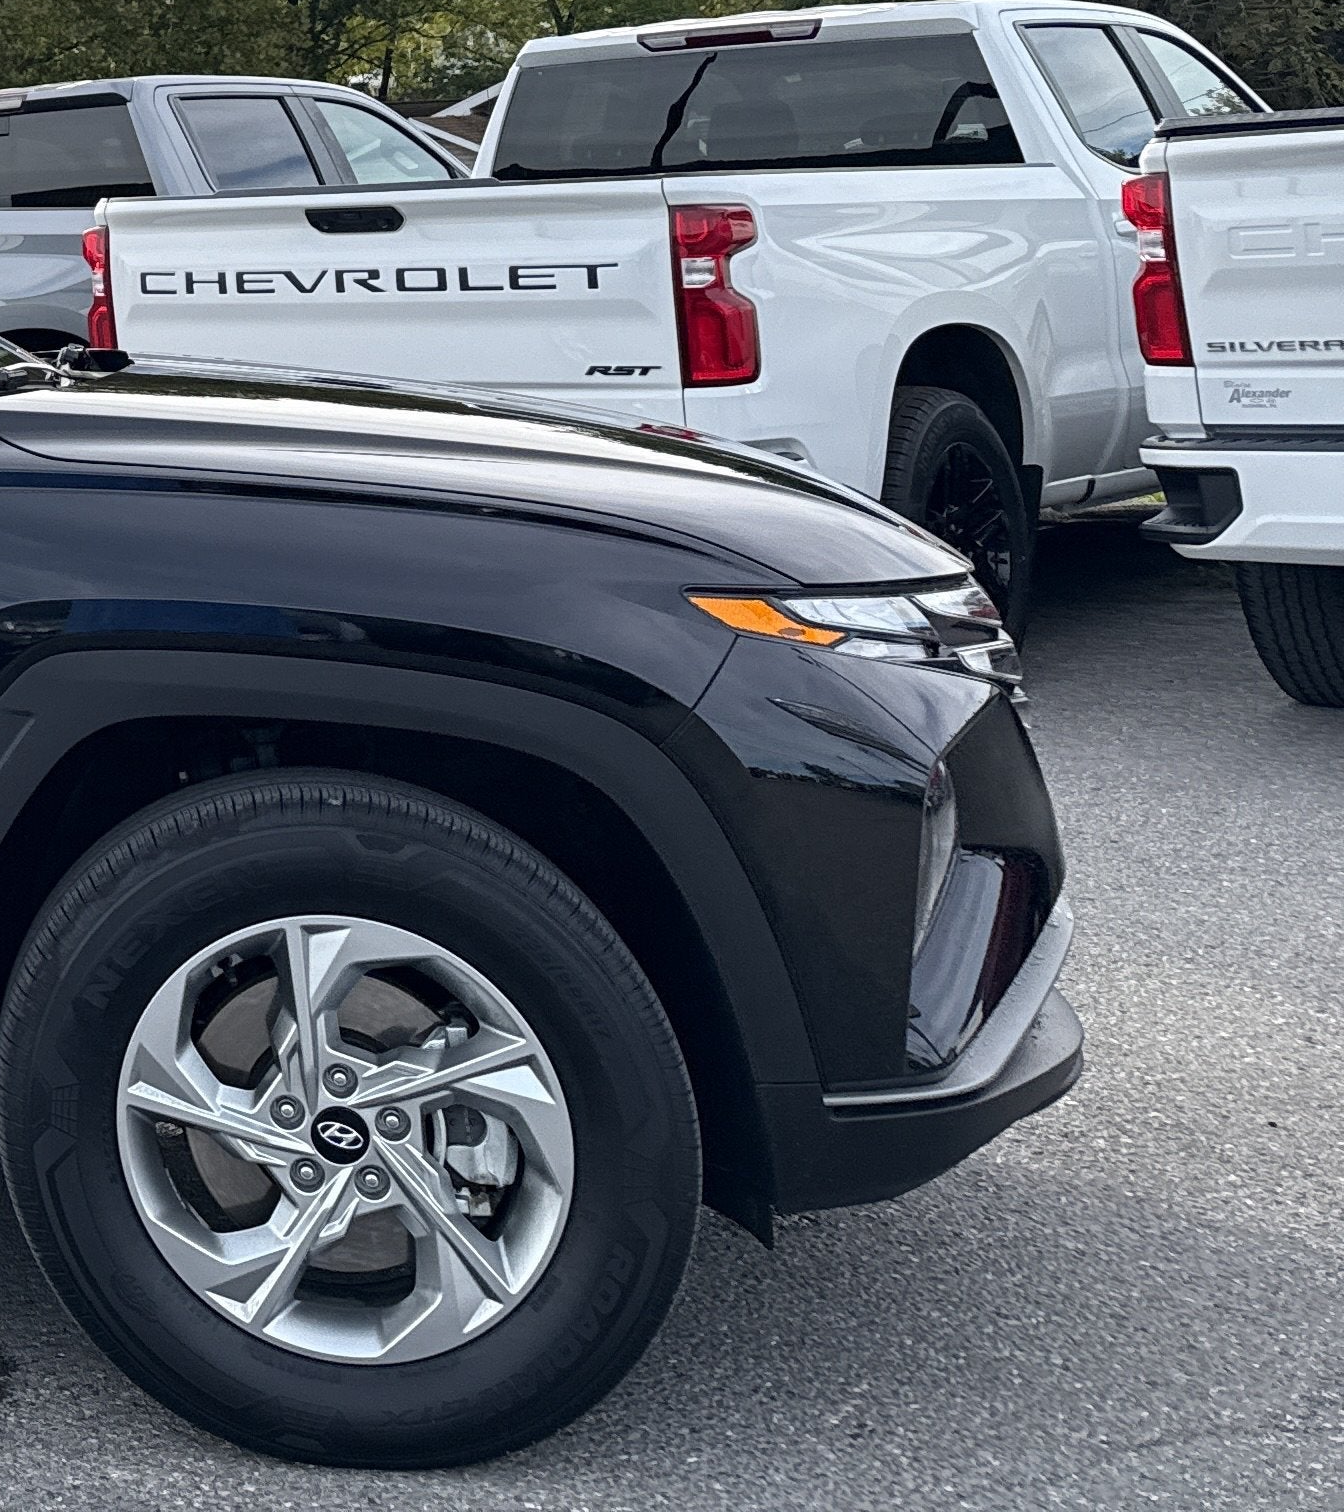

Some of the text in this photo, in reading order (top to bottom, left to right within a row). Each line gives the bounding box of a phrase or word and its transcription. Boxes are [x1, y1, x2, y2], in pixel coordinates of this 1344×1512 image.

[140, 262, 619, 296] CHEVROLET
[1206, 340, 1344, 353] SILVERA
[585, 365, 662, 377] RST
[1228, 387, 1292, 403] Alexander
